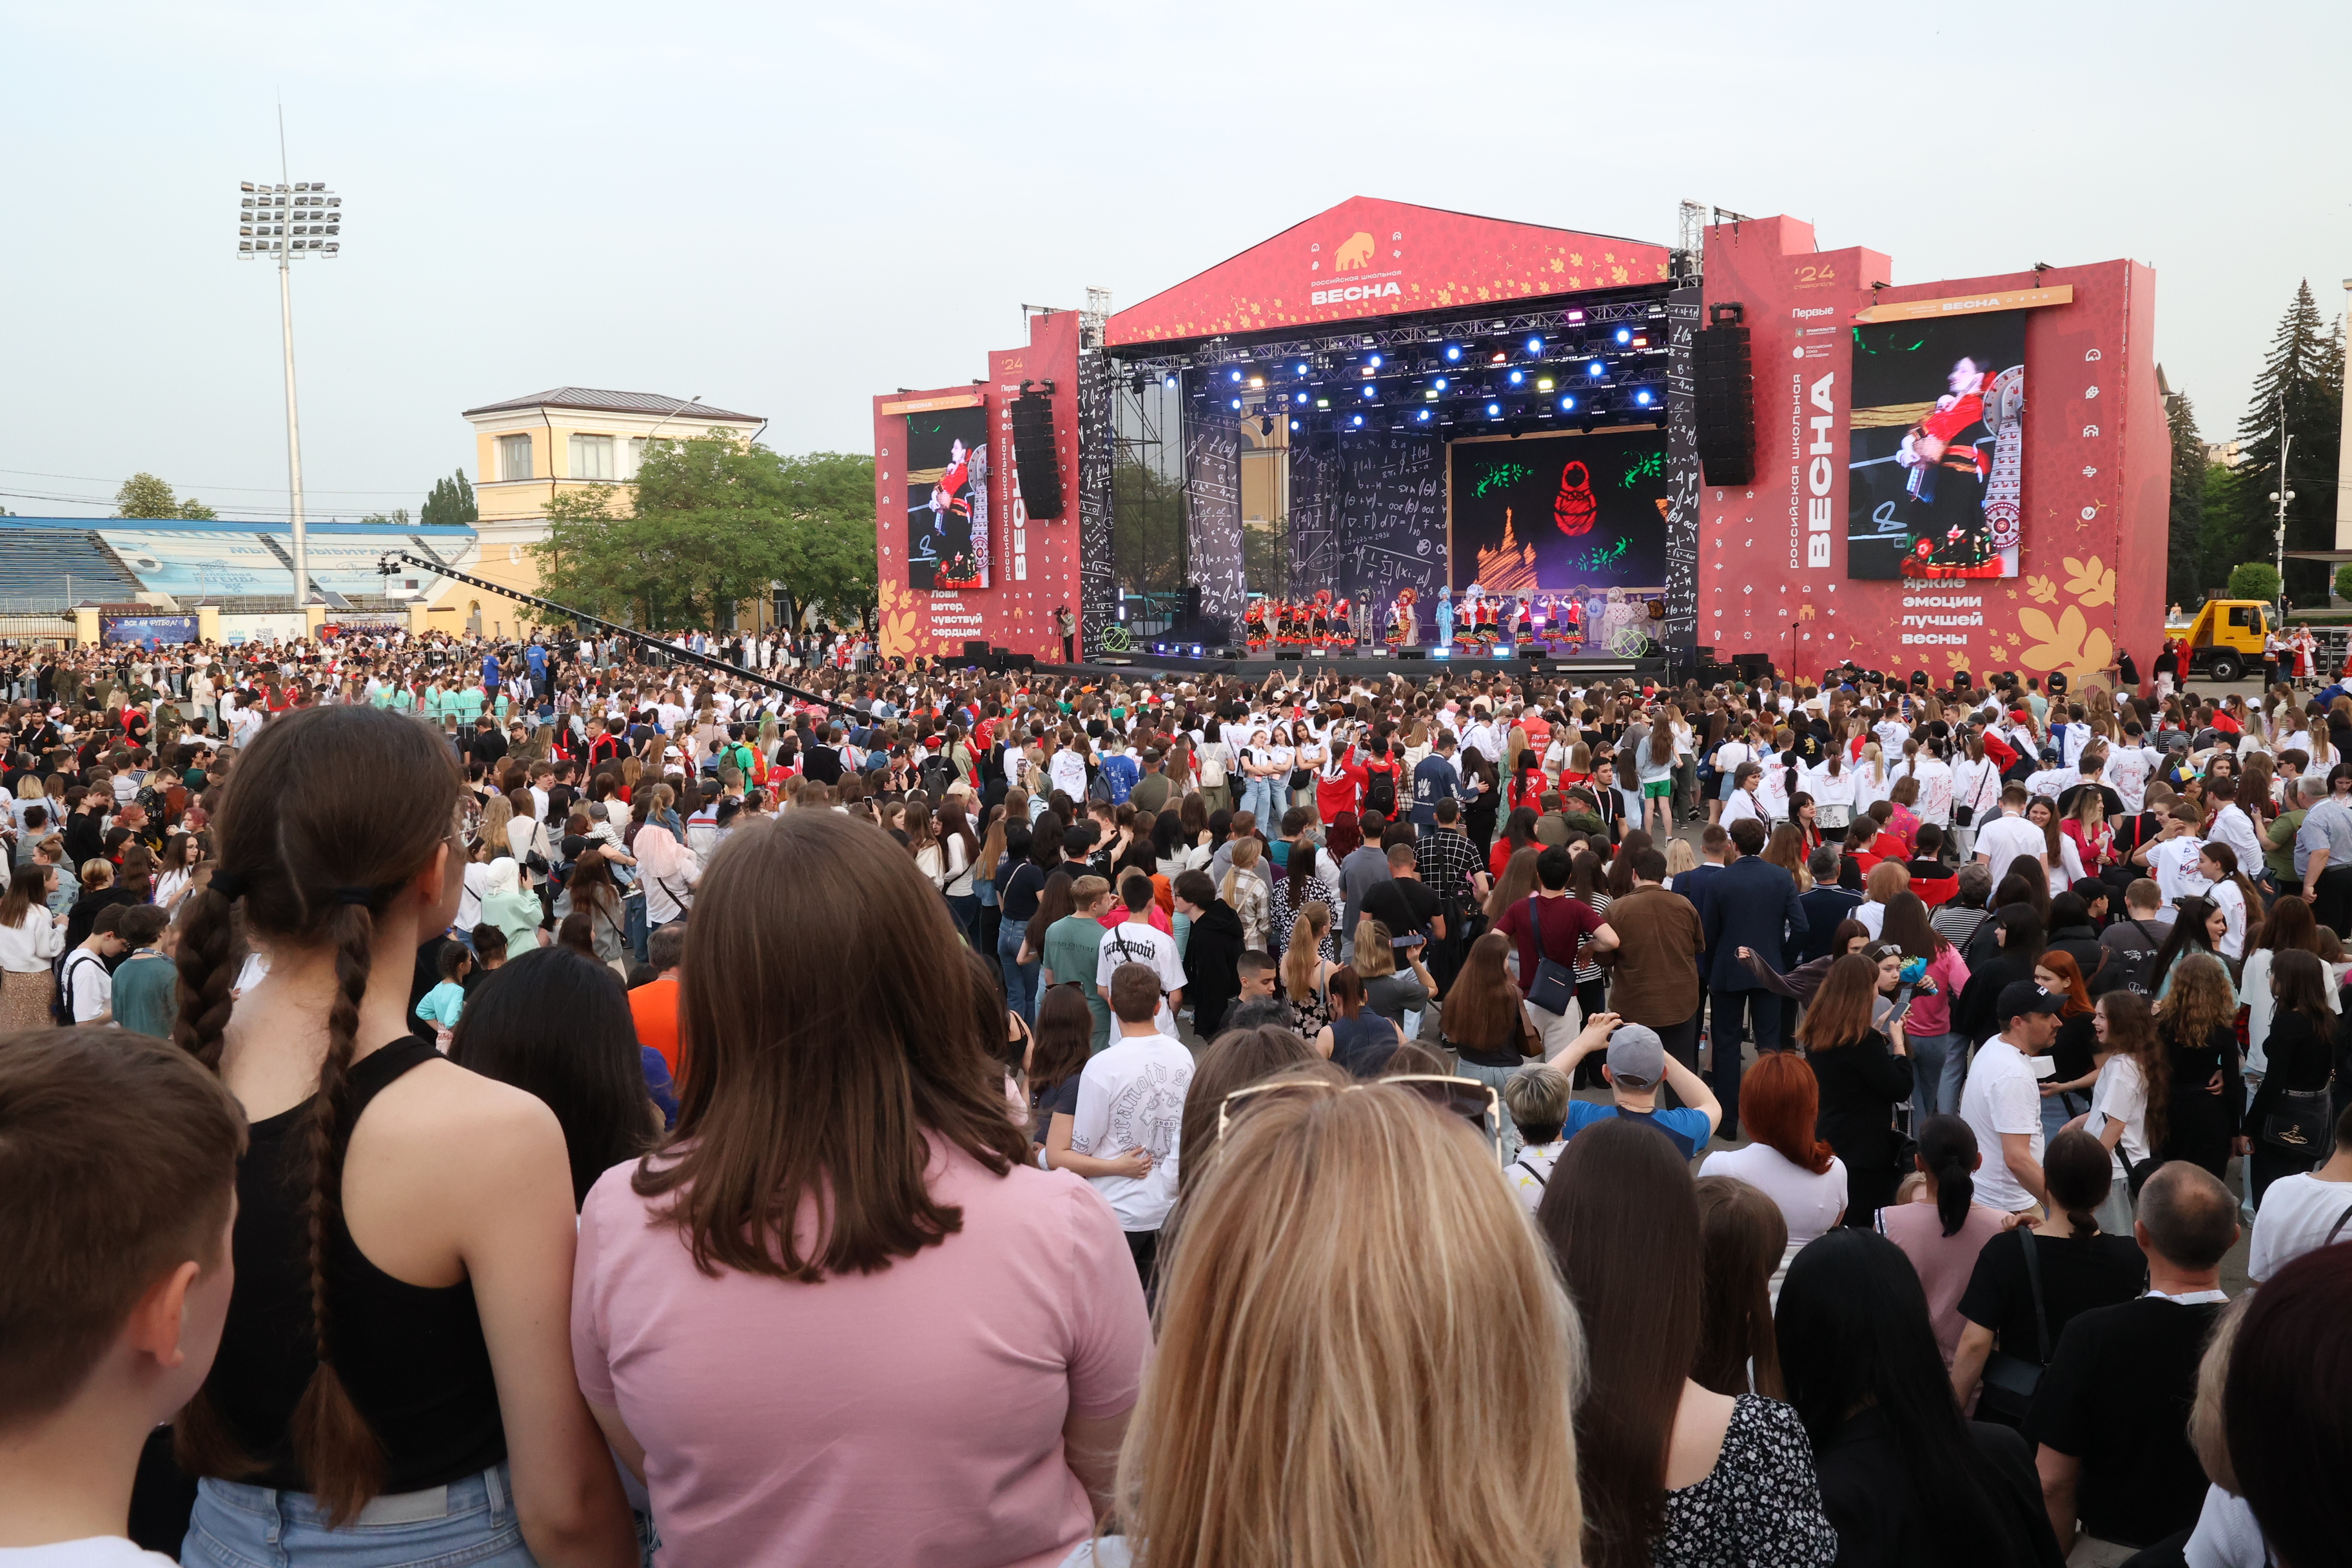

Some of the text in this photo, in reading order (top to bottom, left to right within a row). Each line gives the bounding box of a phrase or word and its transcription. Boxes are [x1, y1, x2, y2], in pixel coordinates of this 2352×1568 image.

[1311, 270, 1402, 288] российская школьная
[1794, 264, 1836, 282] '24
[1311, 281, 1402, 306] ВЕСНА
[1943, 298, 2000, 311] ВЕСНА
[1792, 307, 1834, 320] Первые
[1001, 384, 1021, 393] Первы
[1789, 374, 1801, 569] российская школьная
[1808, 371, 1834, 568] ВЕСНА
[1012, 444, 1026, 580] ВЕС
[1003, 505, 1012, 581] российская
[930, 603, 965, 612] ветер,
[1903, 596, 1982, 608] эмоции
[931, 613, 983, 625] чувствуй
[1902, 611, 1983, 629] лучшей
[932, 628, 981, 638] сердцем
[1902, 634, 1968, 645] весны
